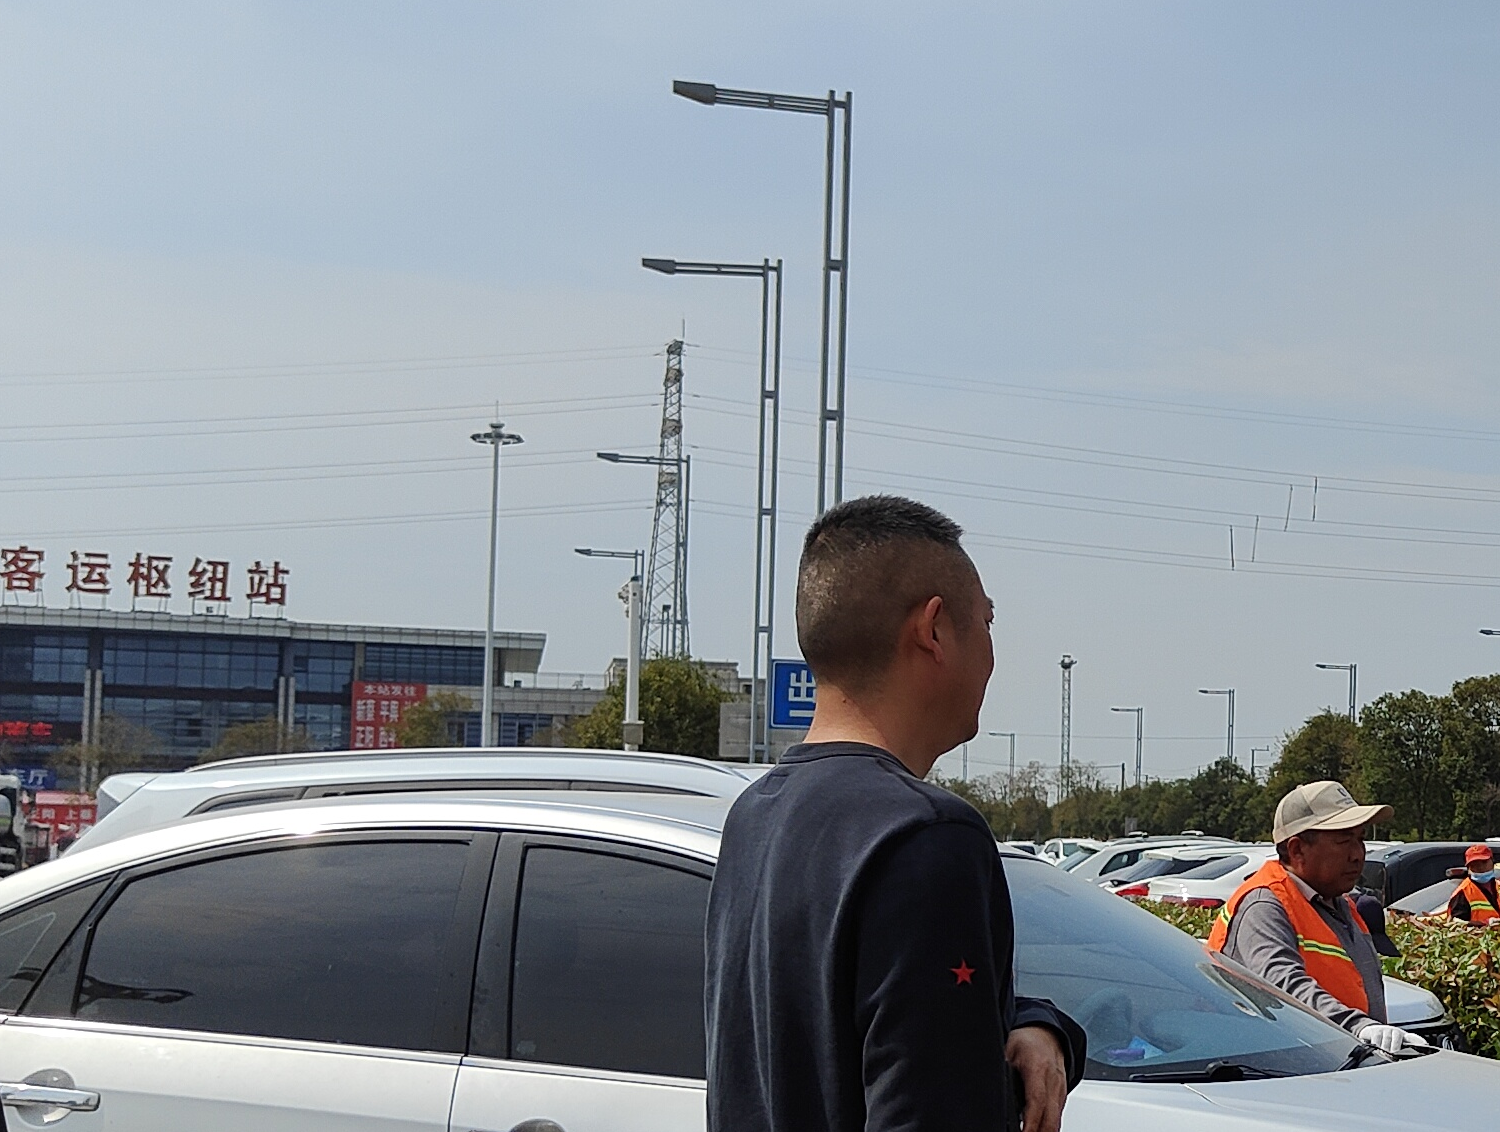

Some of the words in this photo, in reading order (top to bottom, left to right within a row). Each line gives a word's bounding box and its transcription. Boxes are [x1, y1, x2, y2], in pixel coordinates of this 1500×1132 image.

[0, 546, 290, 604] 客运枢纽站
[364, 685, 416, 696] 本站发往
